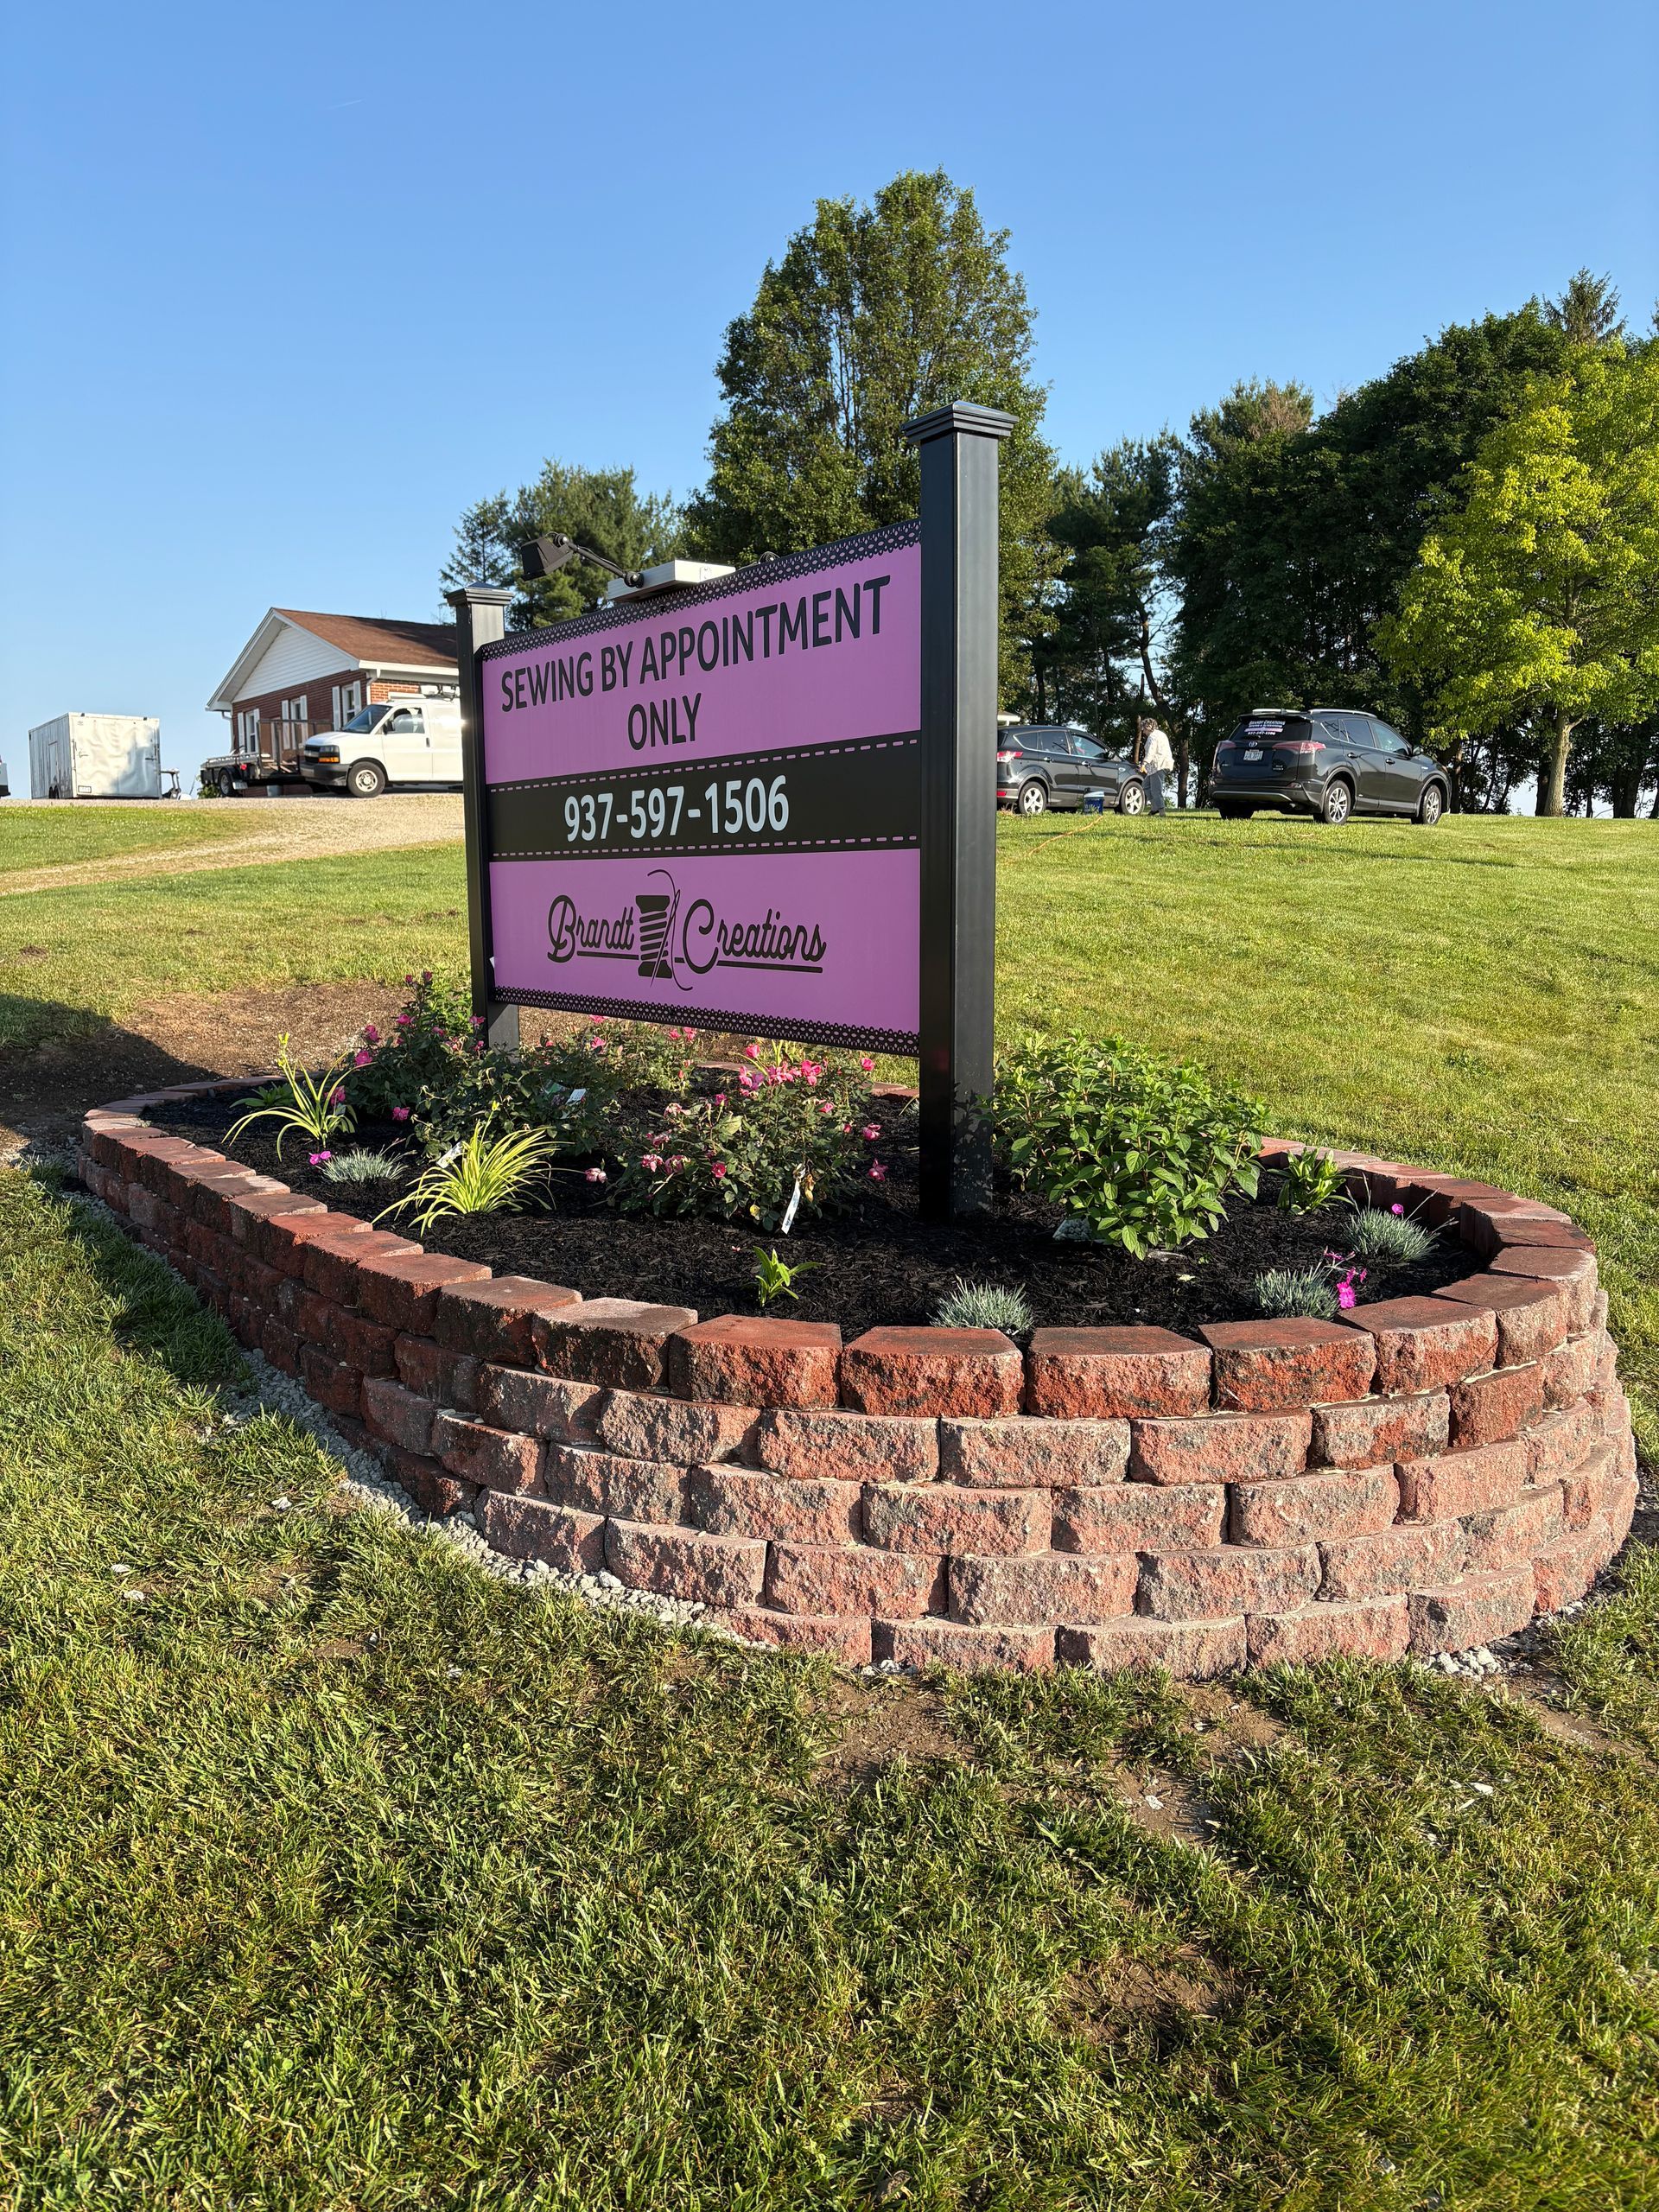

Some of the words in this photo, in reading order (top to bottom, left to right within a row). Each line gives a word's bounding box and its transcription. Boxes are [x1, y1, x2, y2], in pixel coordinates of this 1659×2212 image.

[501, 652, 594, 713] SEWING
[601, 640, 633, 692] BY
[639, 575, 891, 685] APPOINTMENT
[627, 692, 702, 751] ONLY
[564, 774, 790, 842] 937-597-1506
[547, 894, 635, 963] Brandt
[682, 898, 827, 975] Creations
